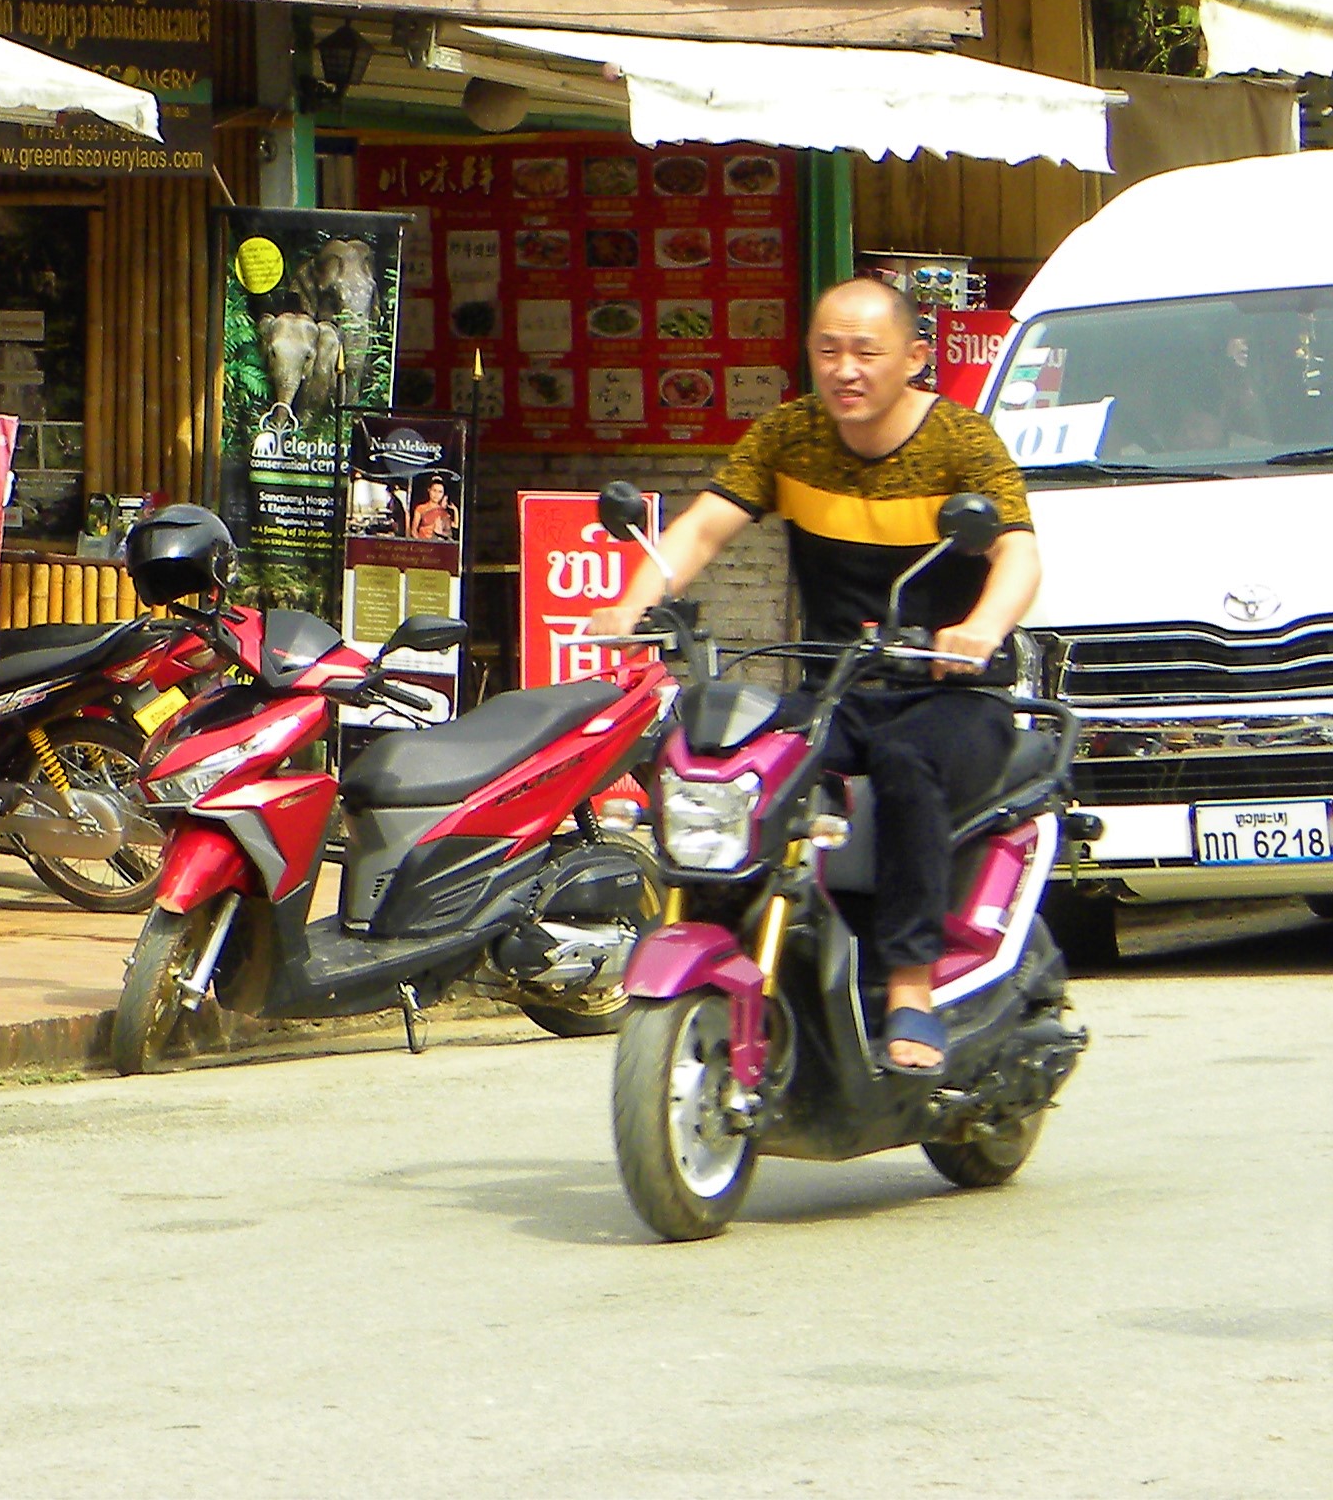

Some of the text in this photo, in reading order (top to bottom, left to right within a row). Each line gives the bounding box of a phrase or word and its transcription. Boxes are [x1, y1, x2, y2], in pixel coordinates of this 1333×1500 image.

[370, 437, 443, 460] Nava Mekong
[1016, 424, 1069, 457] 01
[250, 459, 309, 472] conservation
[1254, 828, 1325, 858] 6218
